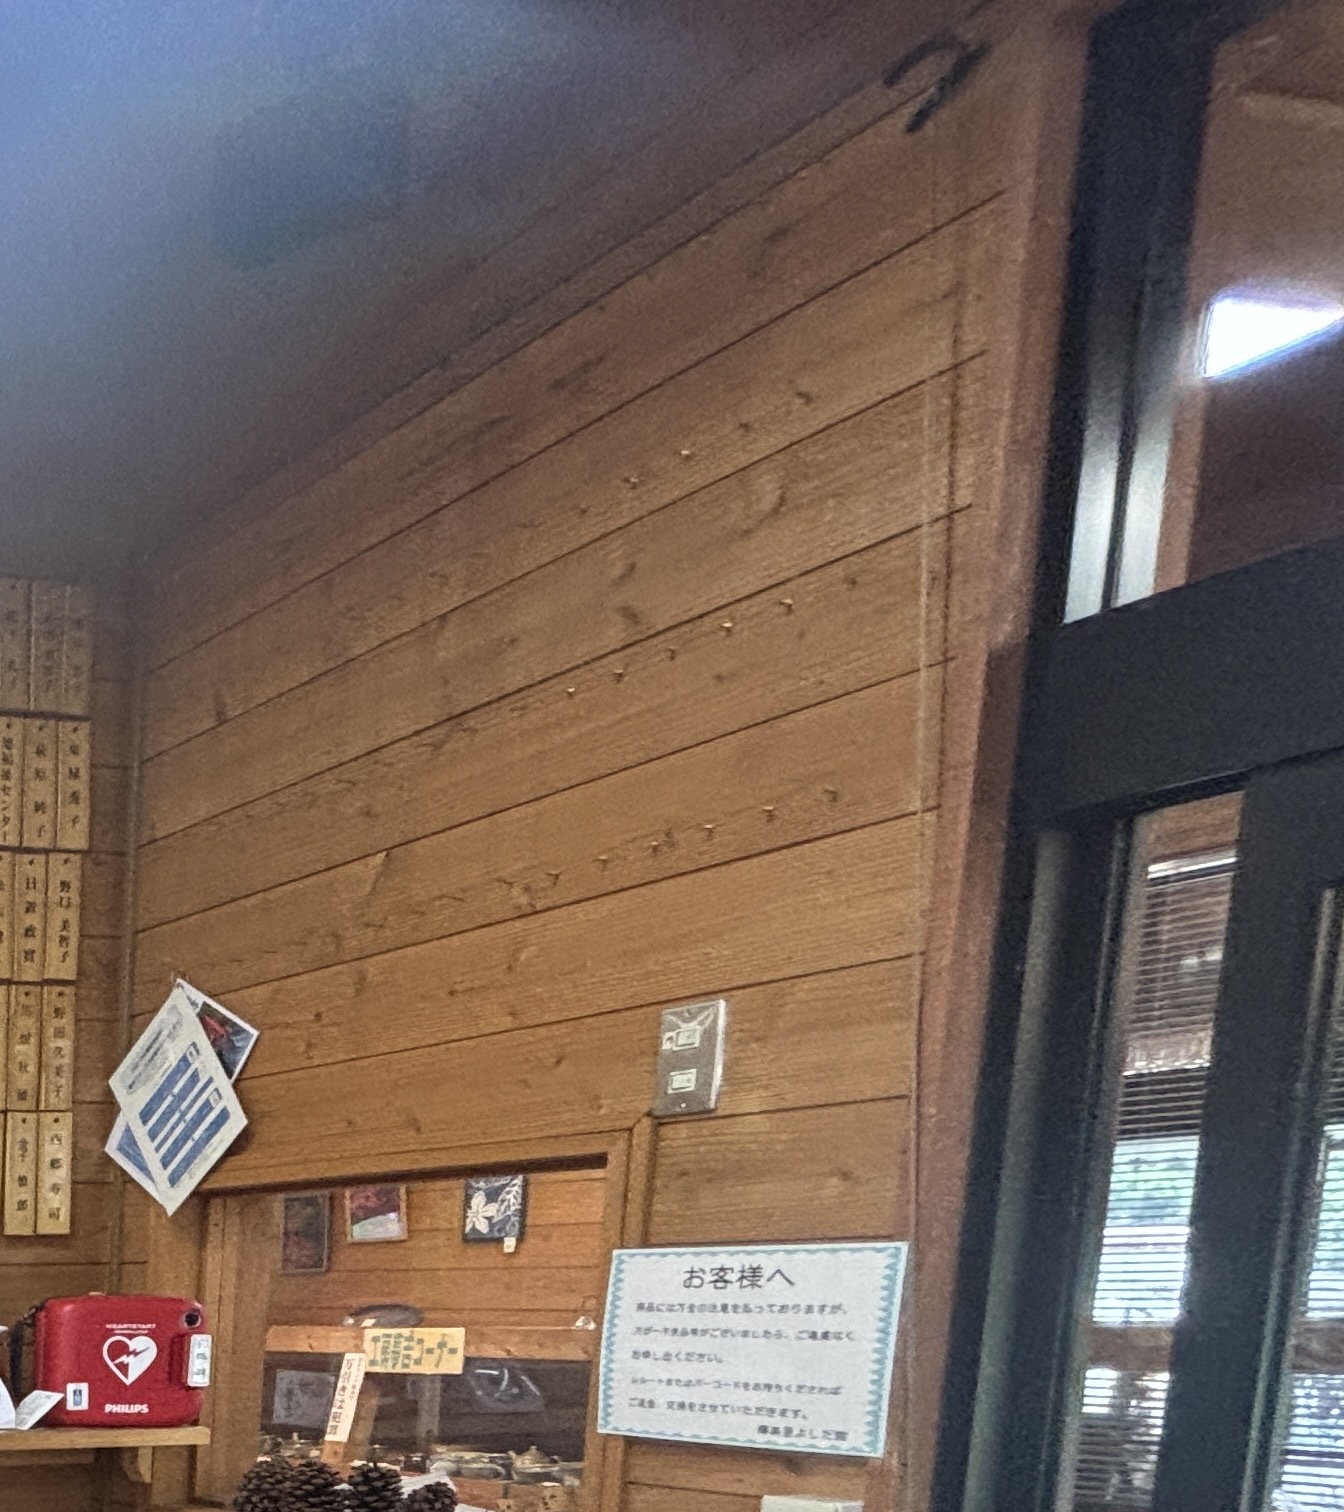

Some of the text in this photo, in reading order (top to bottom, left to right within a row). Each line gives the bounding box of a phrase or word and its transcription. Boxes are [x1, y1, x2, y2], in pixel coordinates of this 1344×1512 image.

[683, 1265, 795, 1289] お客様へ
[105, 1404, 149, 1414] PHILIPS
